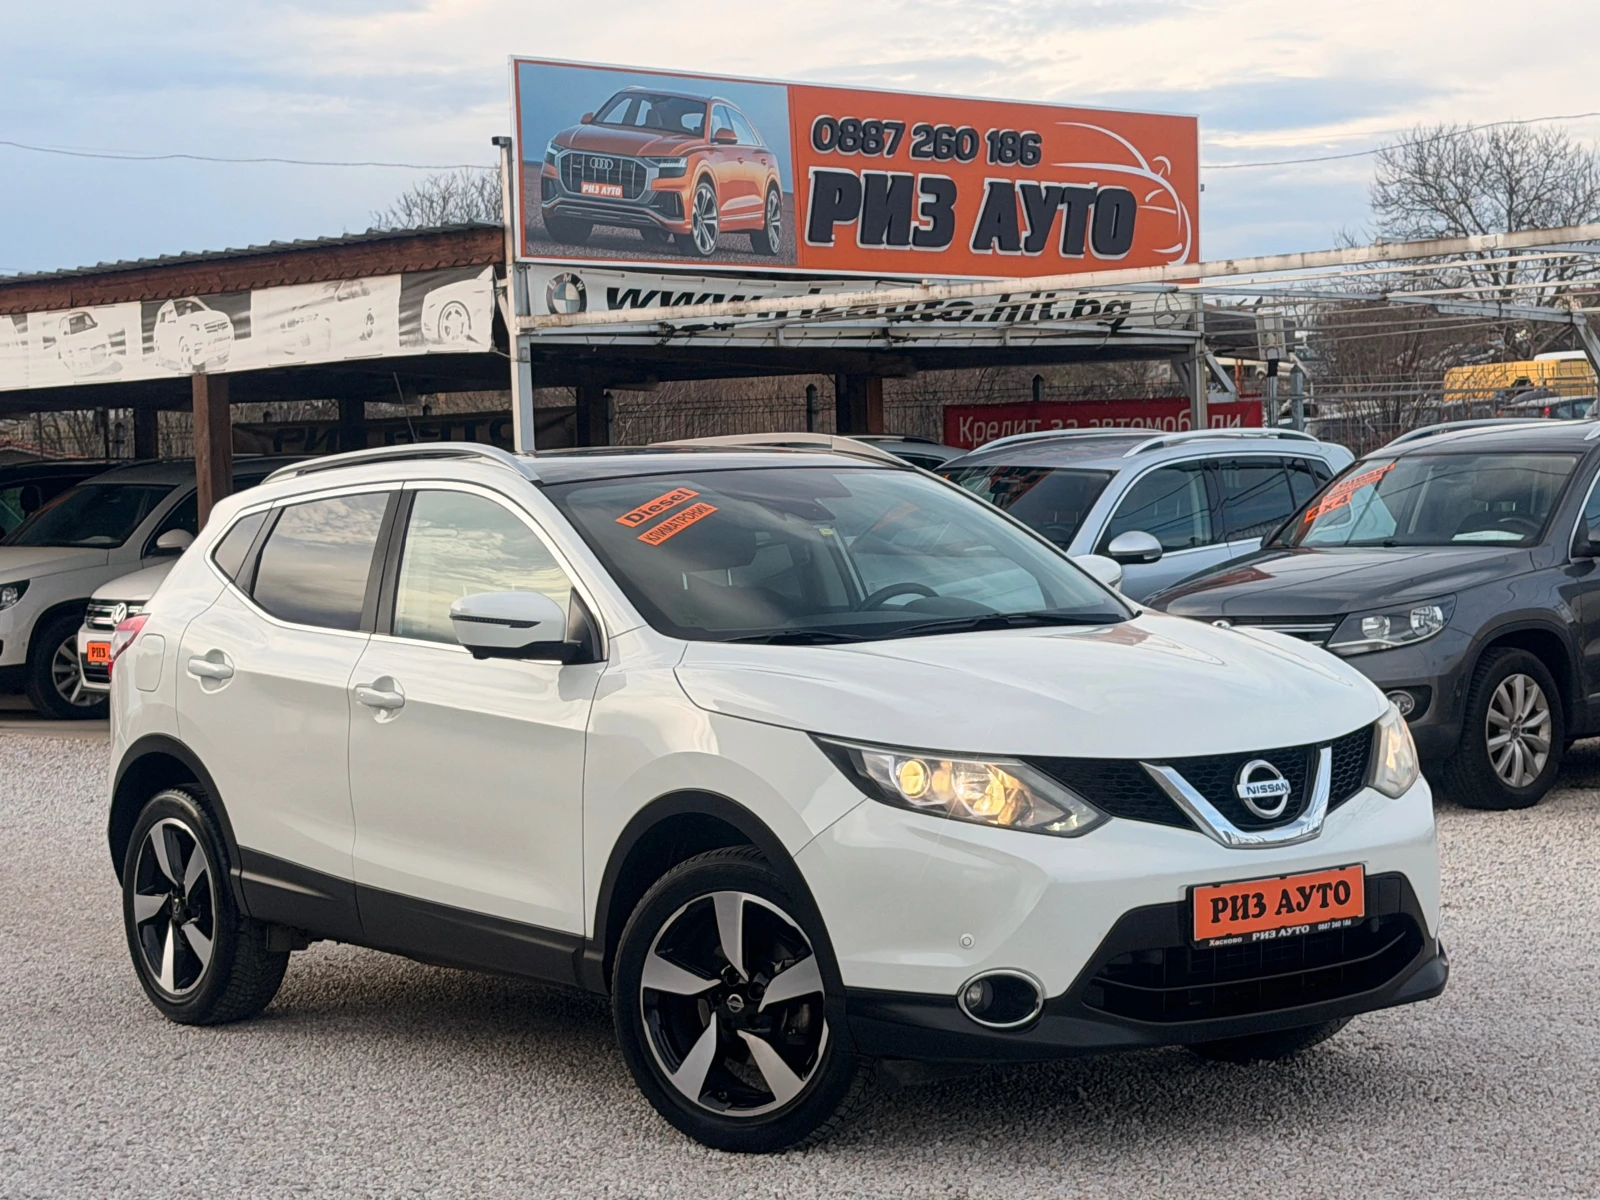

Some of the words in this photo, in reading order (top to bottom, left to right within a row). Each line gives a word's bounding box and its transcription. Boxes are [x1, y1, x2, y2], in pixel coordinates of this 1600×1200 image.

[809, 115, 905, 157] 0887
[910, 123, 979, 162] 260
[985, 129, 1043, 167] 186
[582, 183, 600, 195] РИЗ
[601, 185, 622, 197] АУТО
[805, 167, 957, 251] РИЗ
[969, 177, 1138, 259] АУТО
[1089, 408, 1242, 432] автомобли
[622, 489, 693, 524] Diesel
[1246, 782, 1290, 796] NISSAN
[1210, 892, 1267, 924] РИЗ
[1274, 880, 1351, 916] АУТО
[1252, 931, 1276, 942] РИЗ
[1278, 924, 1310, 938] АУТО
